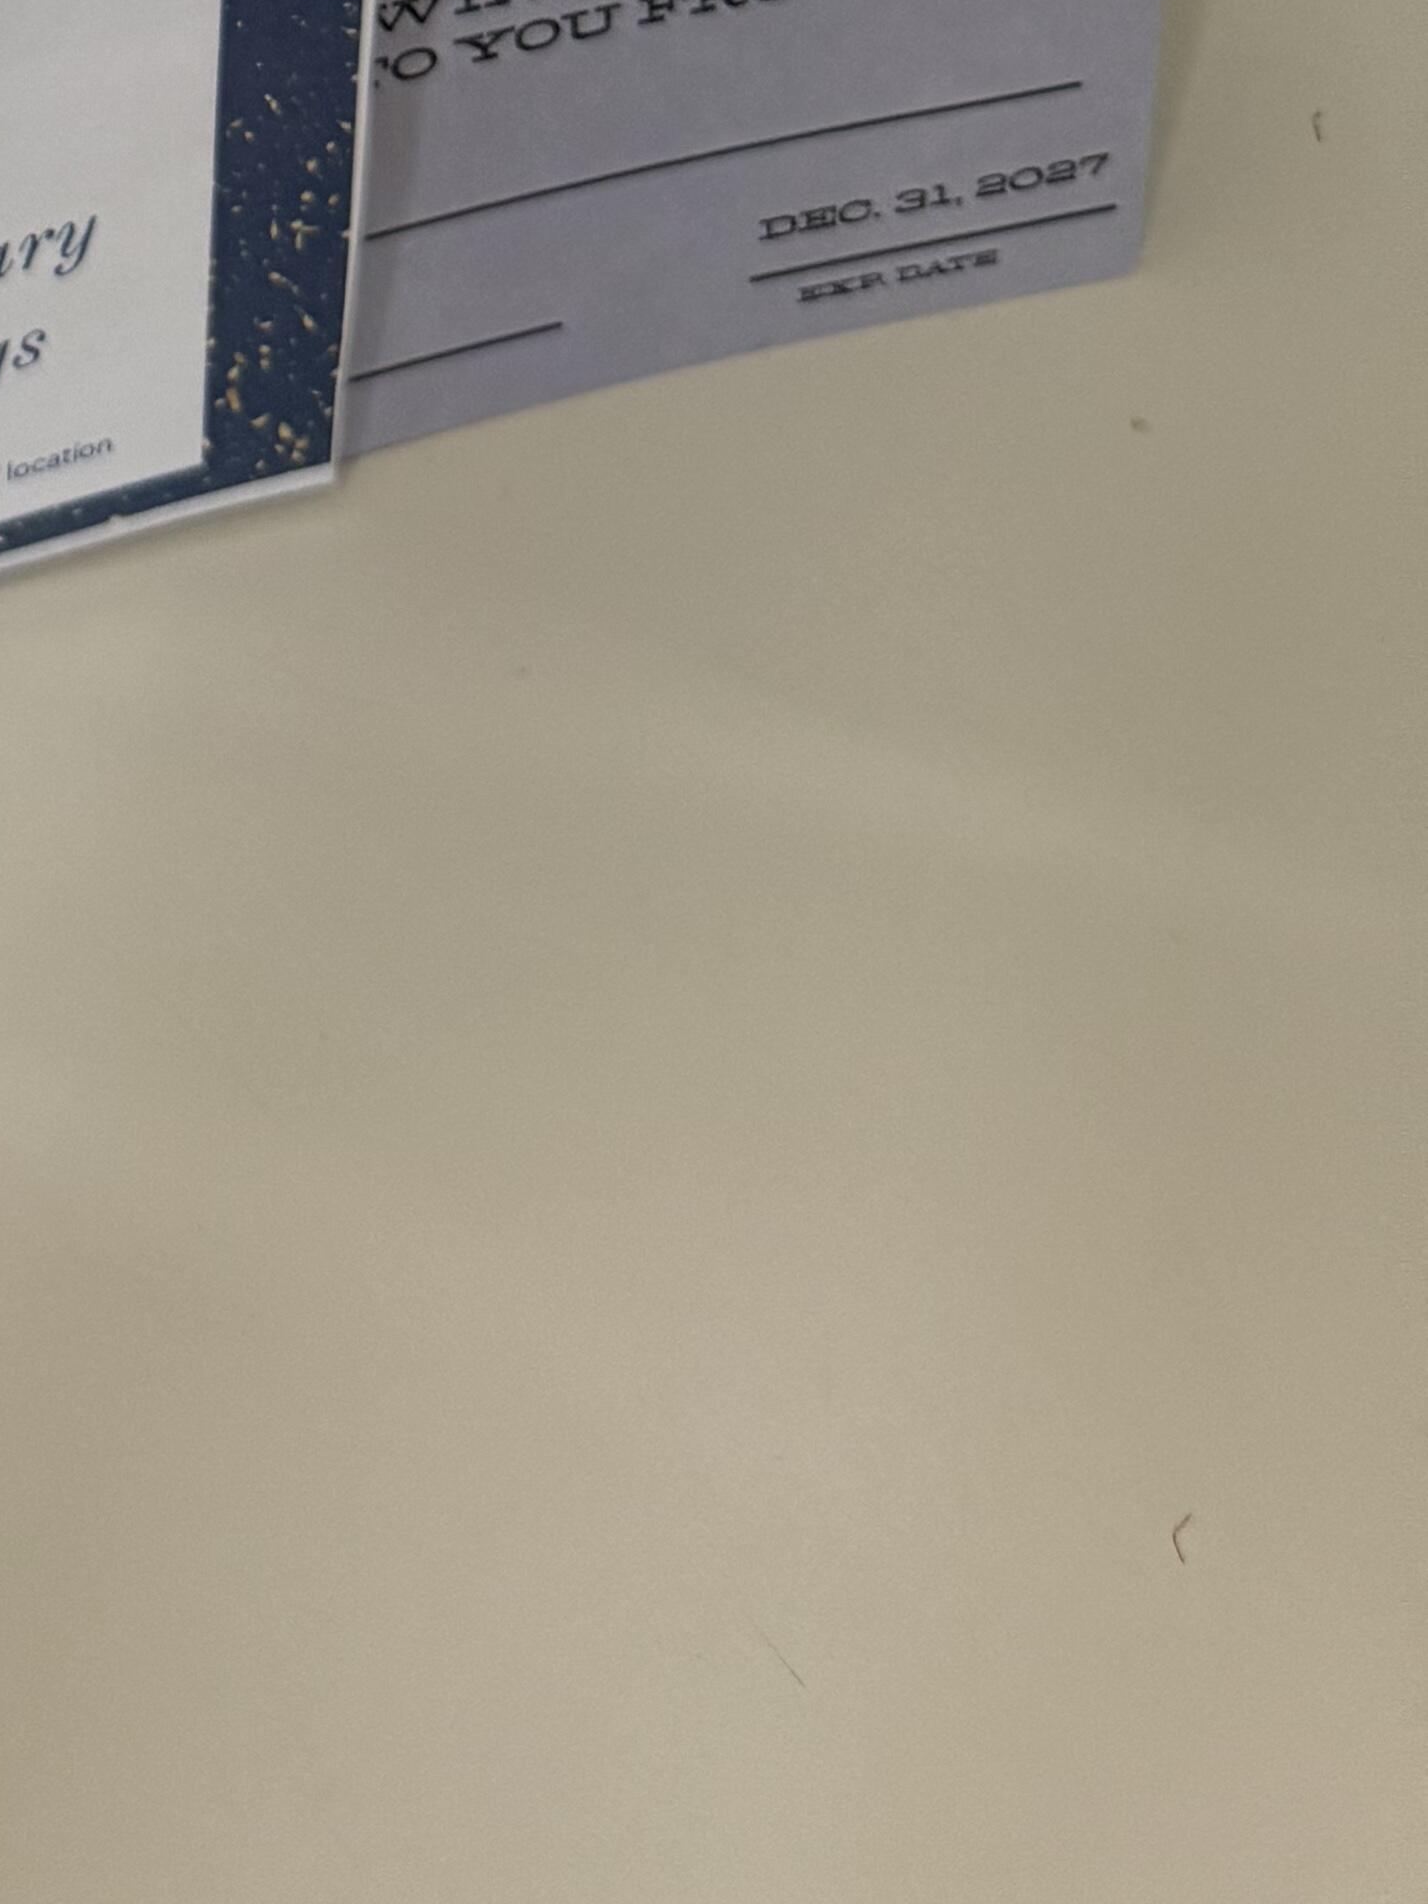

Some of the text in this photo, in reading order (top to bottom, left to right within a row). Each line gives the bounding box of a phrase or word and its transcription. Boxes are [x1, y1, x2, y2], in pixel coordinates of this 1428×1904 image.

[453, 2, 623, 63] YOU
[758, 151, 1110, 242] DEC. 31, 2027
[895, 248, 1000, 283] DATE
[6, 436, 116, 483] location
